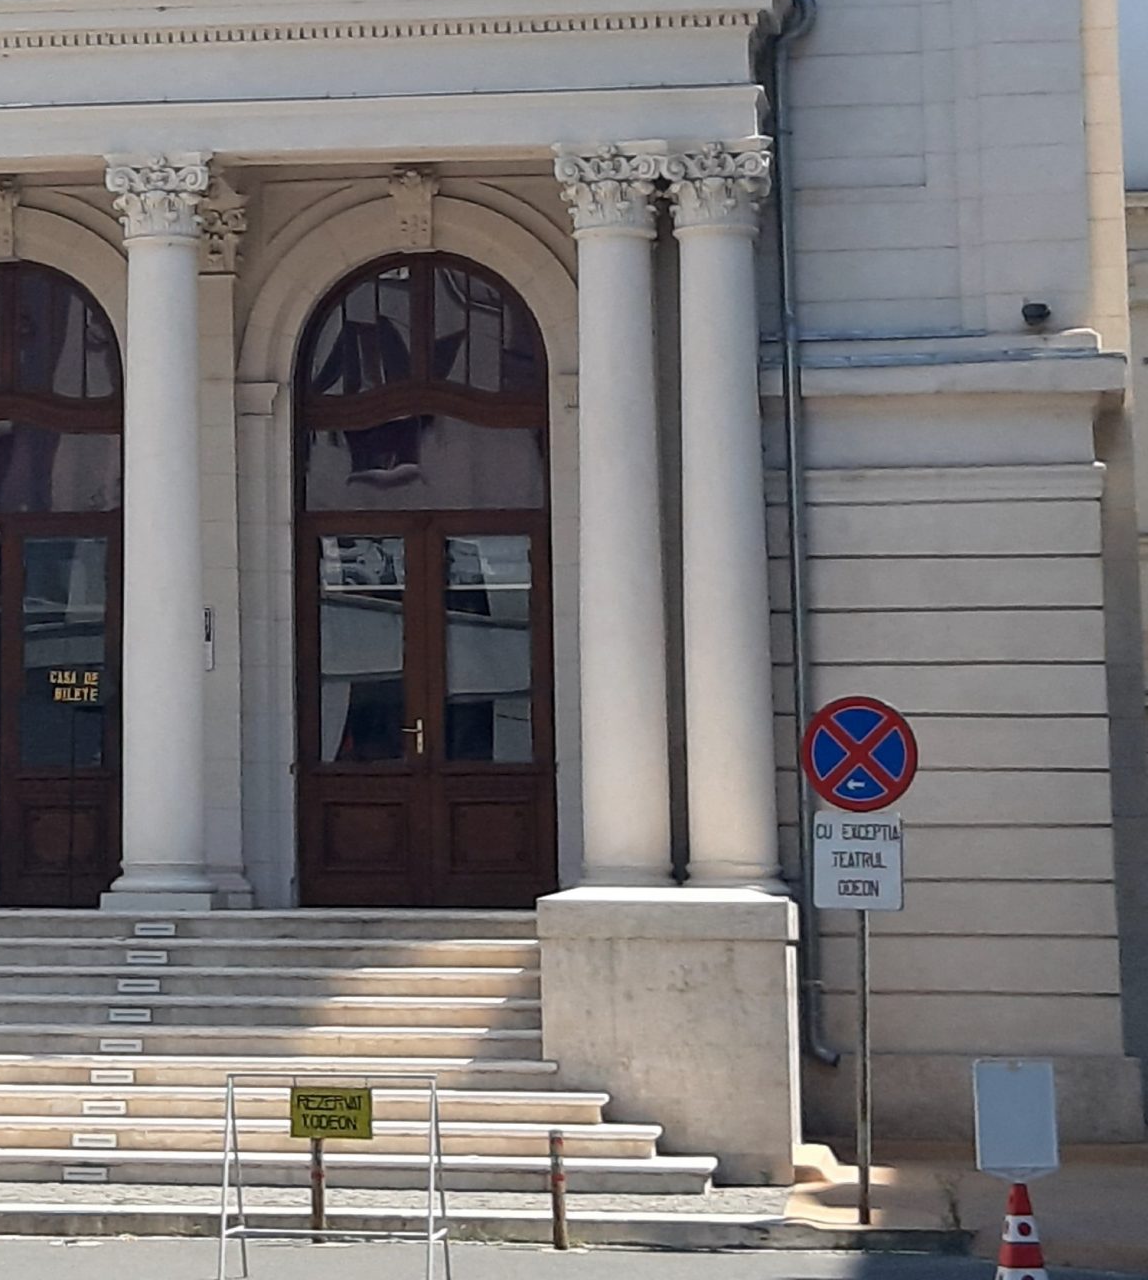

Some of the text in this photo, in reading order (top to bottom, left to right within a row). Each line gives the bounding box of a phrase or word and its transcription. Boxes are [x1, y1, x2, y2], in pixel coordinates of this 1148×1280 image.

[50, 670, 99, 685] CASA DE
[816, 824, 832, 839] CU
[831, 851, 886, 869] TEATRUL
[838, 880, 879, 897] ODEON
[297, 1094, 363, 1110] REZERVAT
